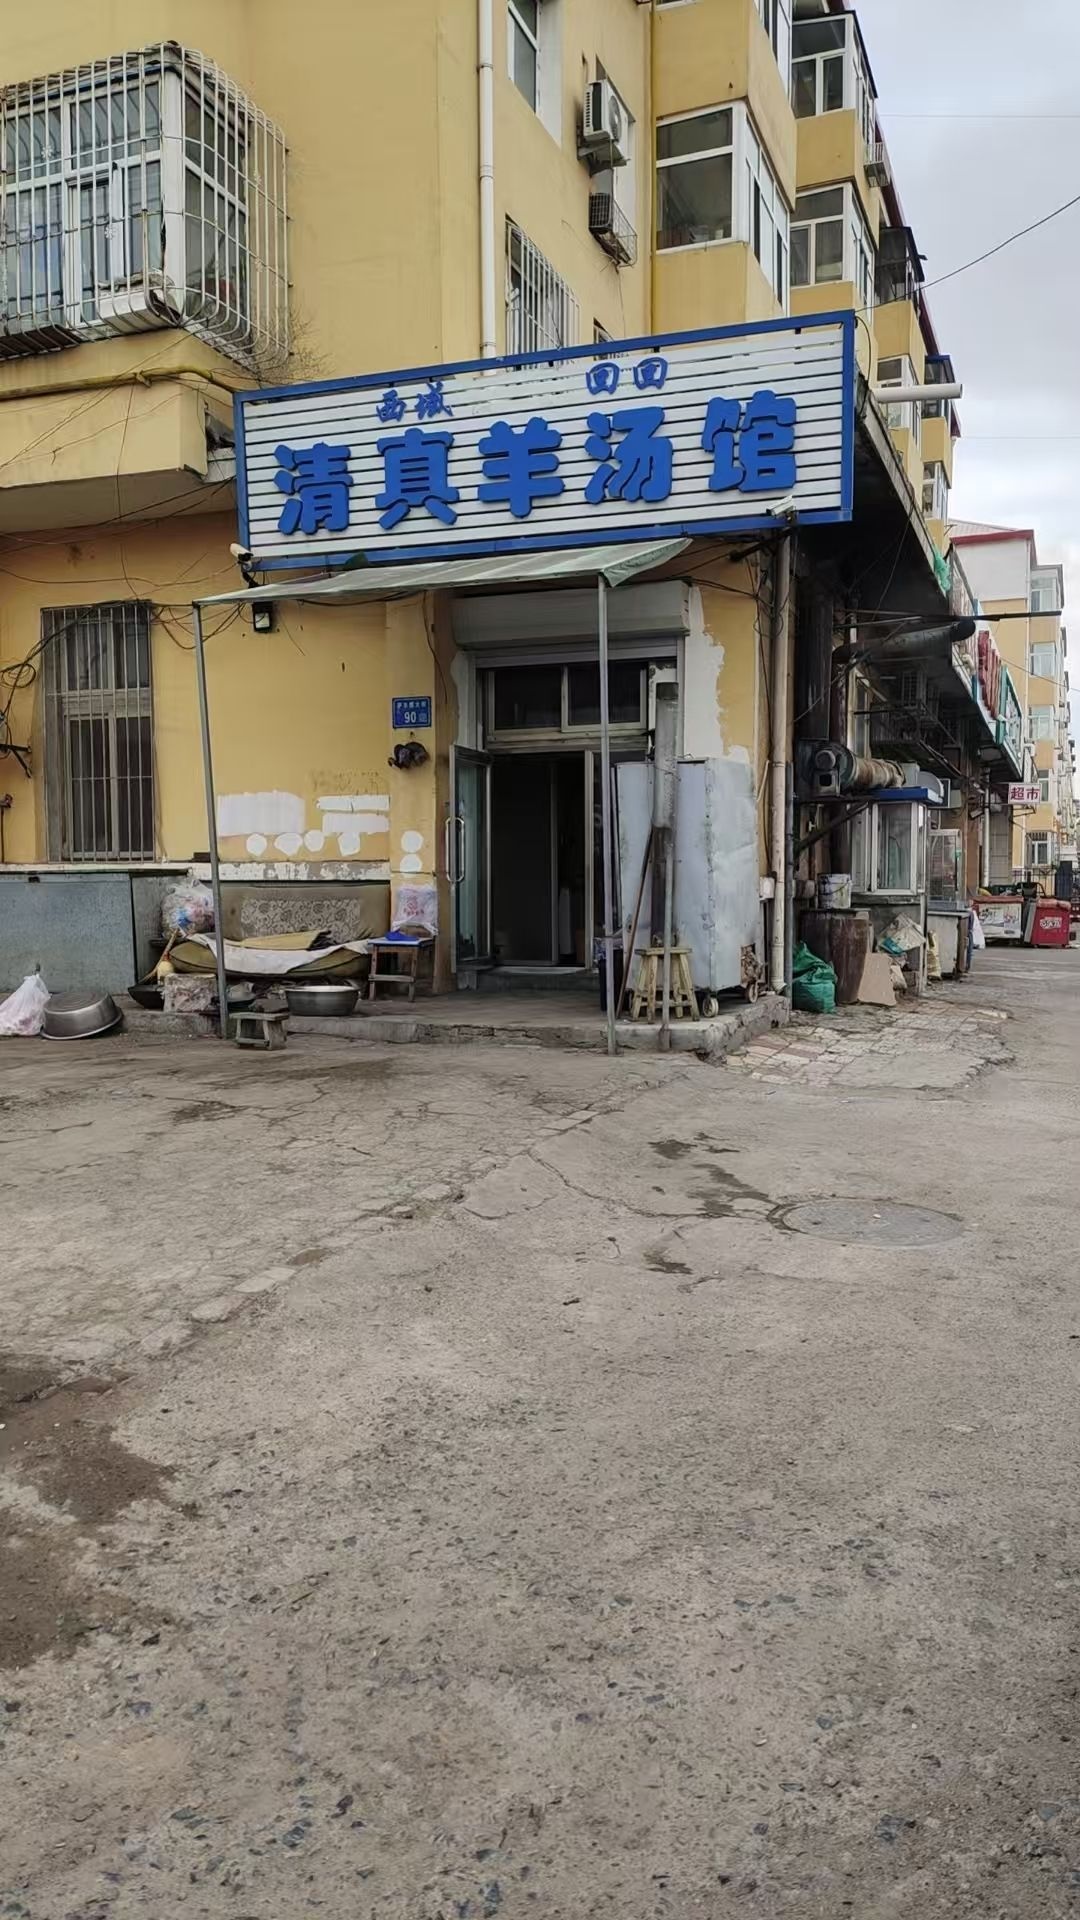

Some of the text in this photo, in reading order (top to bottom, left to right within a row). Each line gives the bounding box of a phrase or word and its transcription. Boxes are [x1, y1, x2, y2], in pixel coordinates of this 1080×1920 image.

[586, 357, 668, 395] 回回
[271, 390, 799, 535] 清真羊汤馆
[404, 711, 417, 723] 90
[1010, 787, 1040, 801] 超市
